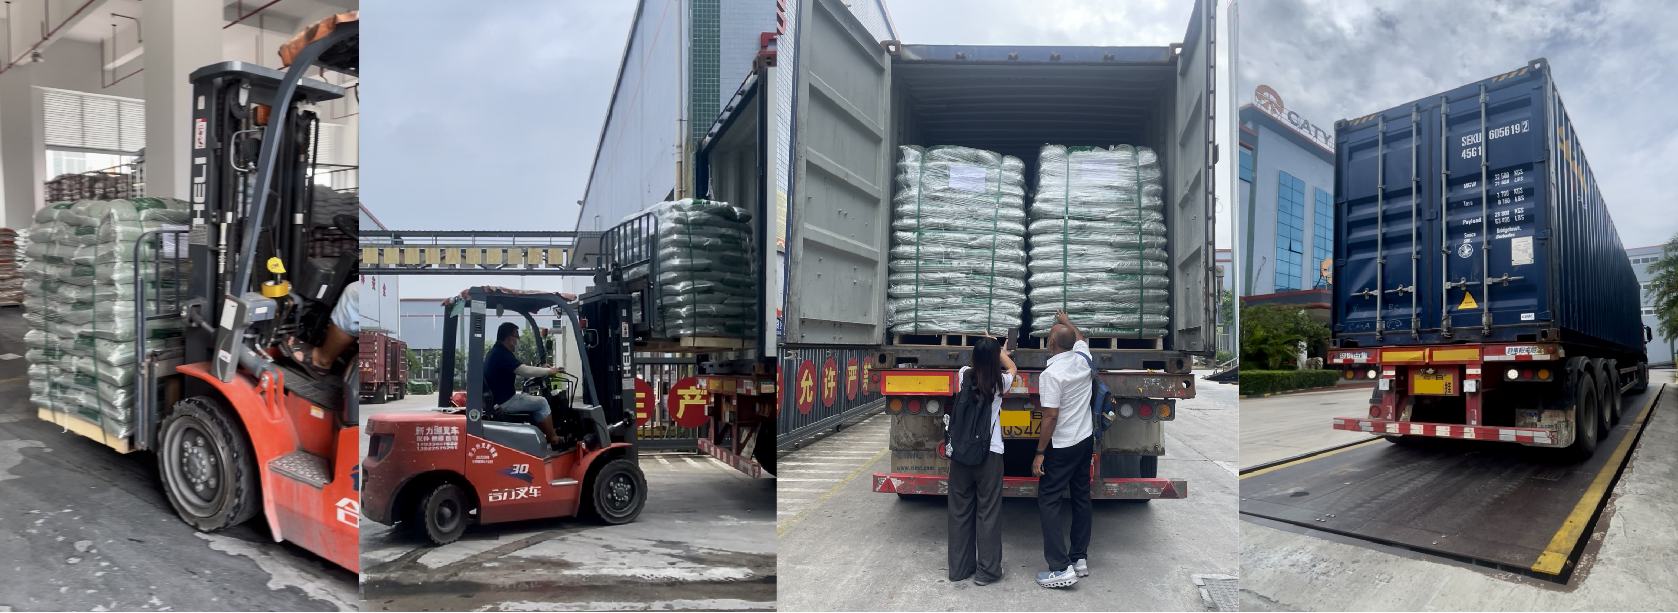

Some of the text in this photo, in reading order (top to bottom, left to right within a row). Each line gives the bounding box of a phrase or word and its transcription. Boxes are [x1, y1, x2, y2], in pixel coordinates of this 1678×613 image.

[1461, 120, 1530, 147] SEKU 605619 2
[192, 156, 207, 225] HELI
[622, 342, 631, 377] HELI
[510, 463, 530, 475] 30
